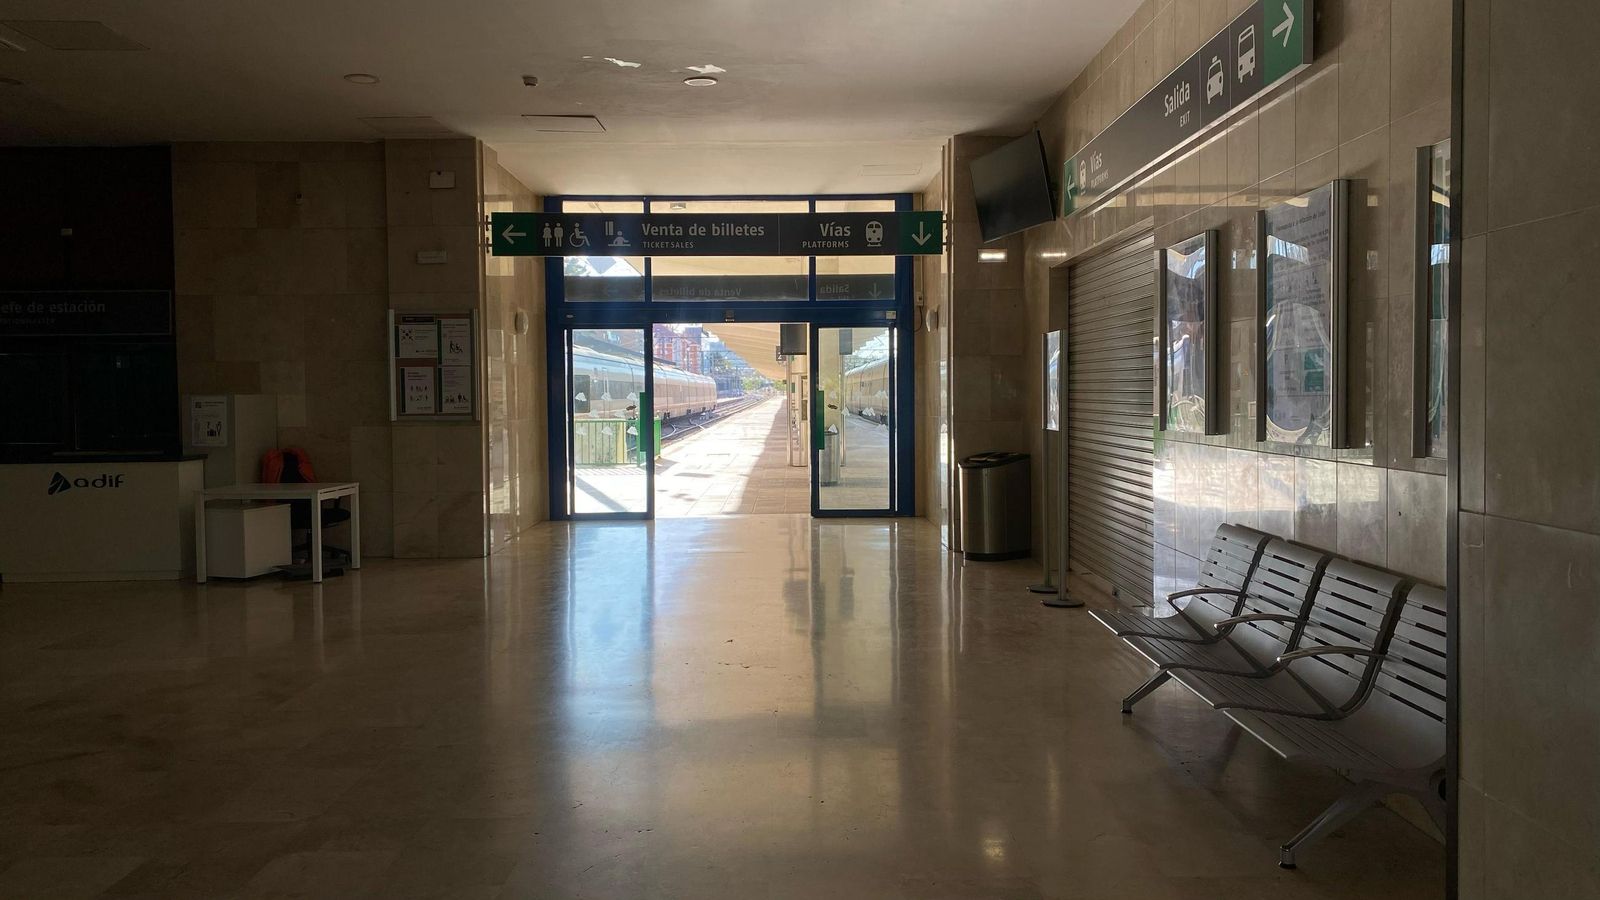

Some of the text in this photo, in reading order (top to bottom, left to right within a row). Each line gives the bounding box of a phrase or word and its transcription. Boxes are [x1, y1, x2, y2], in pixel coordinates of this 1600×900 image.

[1164, 81, 1190, 117] Salida
[1180, 110, 1190, 127] EXIT
[641, 223, 765, 236] Venta de billetes
[820, 221, 851, 237] Vías
[643, 241, 694, 249] TICKET SALES
[802, 240, 849, 248] PLATFORMS
[26, 300, 44, 313] de
[49, 298, 106, 313] estación
[73, 474, 125, 489] adif
